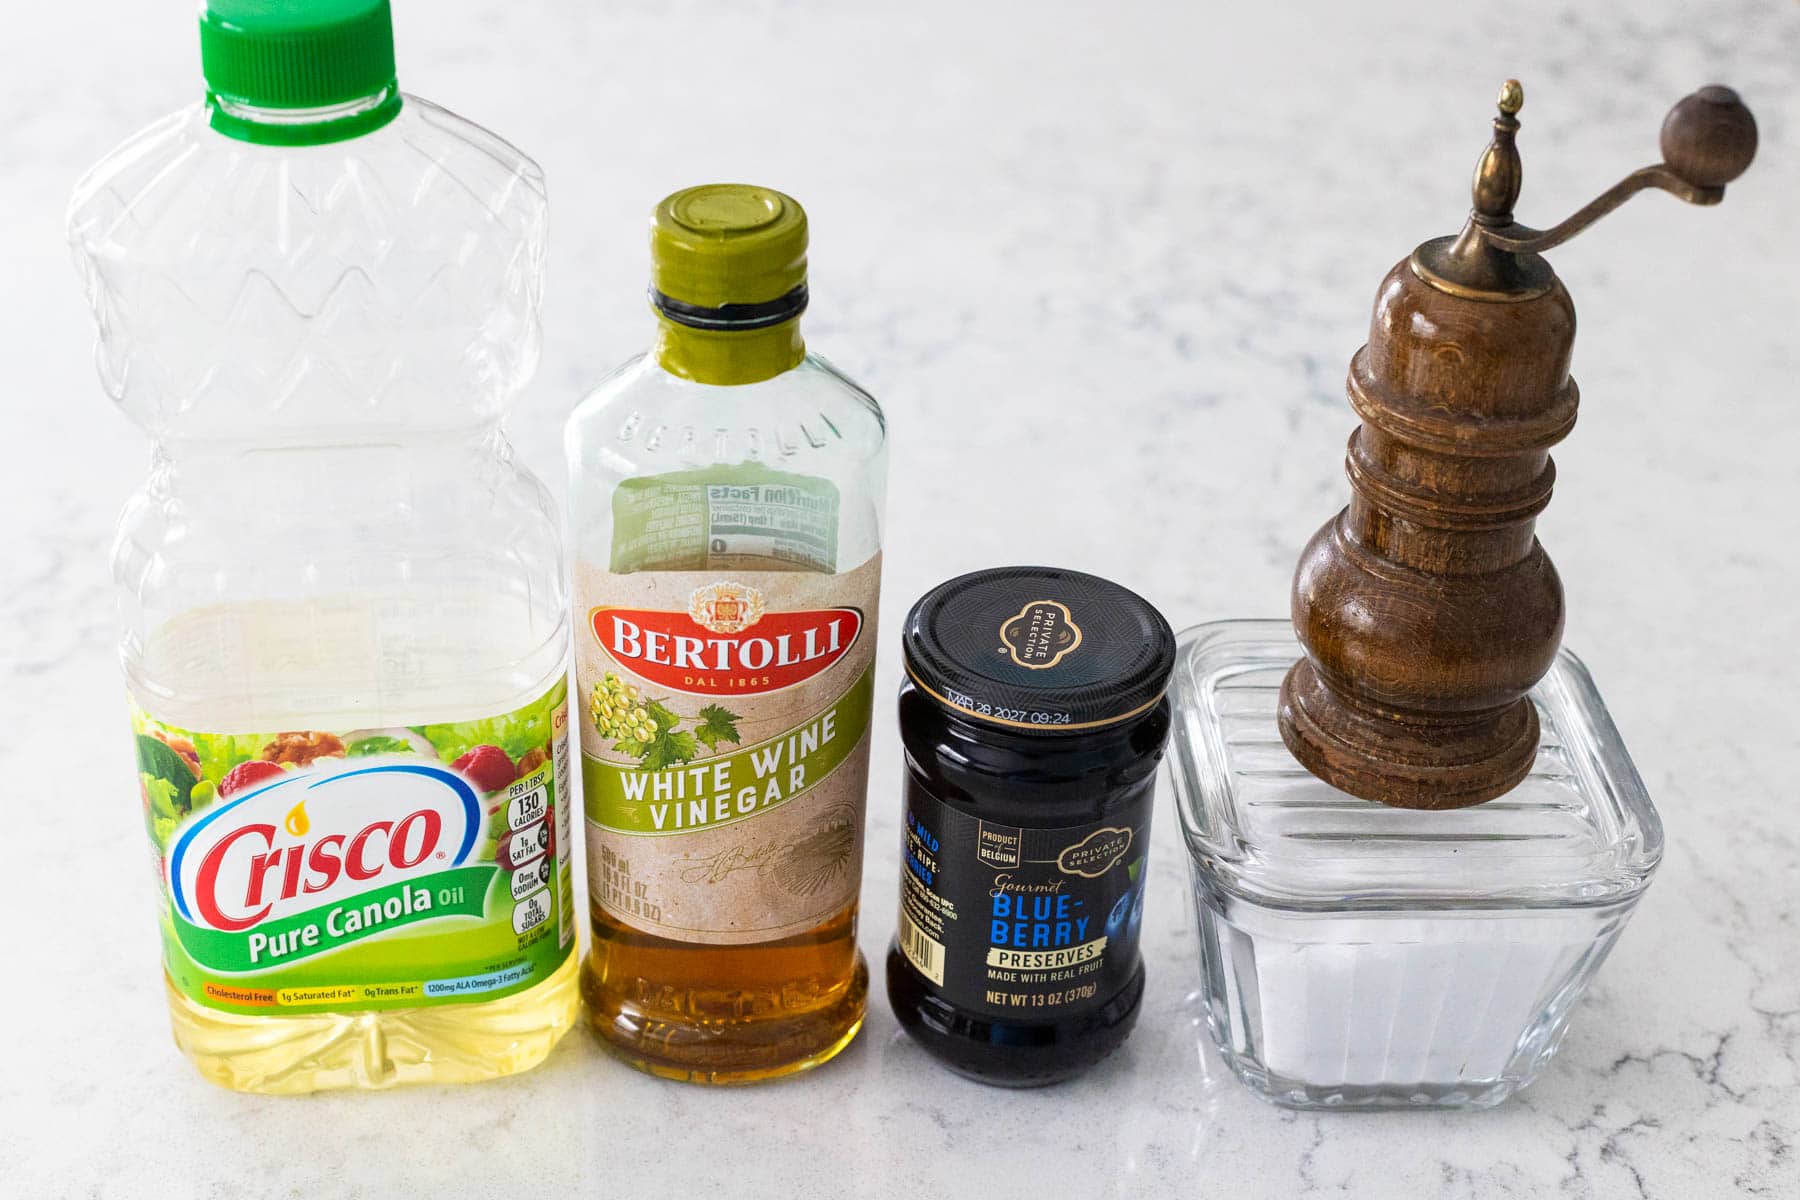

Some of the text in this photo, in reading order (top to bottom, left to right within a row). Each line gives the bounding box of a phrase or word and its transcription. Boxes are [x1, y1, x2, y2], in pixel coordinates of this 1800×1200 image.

[612, 616, 842, 671] BERTOLLI
[1024, 609, 1042, 660] SELECTION
[1035, 612, 1056, 659] PRIVATE
[684, 676, 770, 688] DAL 1865
[976, 702, 991, 717] 28
[994, 706, 1026, 722] 2027
[1031, 712, 1071, 725] 09:24
[620, 709, 837, 801] WHITE WINE
[510, 784, 524, 797] PER
[530, 772, 545, 787] TBSP
[518, 792, 539, 815] 130
[650, 764, 805, 830] VINEGAR
[514, 806, 544, 827] CALORIES
[982, 831, 1017, 845] PRODUCT
[1072, 837, 1123, 860] PRIVATE
[512, 843, 536, 861] SAT FAT
[981, 848, 1016, 864] BELGIUM
[1069, 843, 1125, 867] SELECTION
[195, 808, 442, 931] Crisco
[513, 878, 538, 897] SODIUM
[634, 881, 648, 900] OZ
[989, 873, 1066, 898] Gourmet
[524, 905, 542, 921] TOTAL
[993, 893, 1084, 921] BLUE-
[247, 886, 464, 964] Pure Canola Oil
[521, 912, 546, 931] SUGARS
[990, 916, 1089, 947] BERRY
[999, 944, 1094, 968] PRESERVES
[428, 983, 455, 992] 1200mg
[456, 981, 470, 990] ALA
[471, 975, 502, 988] Omega-3
[503, 972, 520, 982] Fatty
[987, 958, 1104, 983] MADE WITH REAL FRUIT
[206, 985, 273, 1001] Cholesterol Free
[281, 993, 292, 1003] 1g
[293, 990, 336, 1001] Saturated
[376, 987, 398, 996] Trans
[986, 982, 1097, 1007] NET WT 13 OZ (370g)
